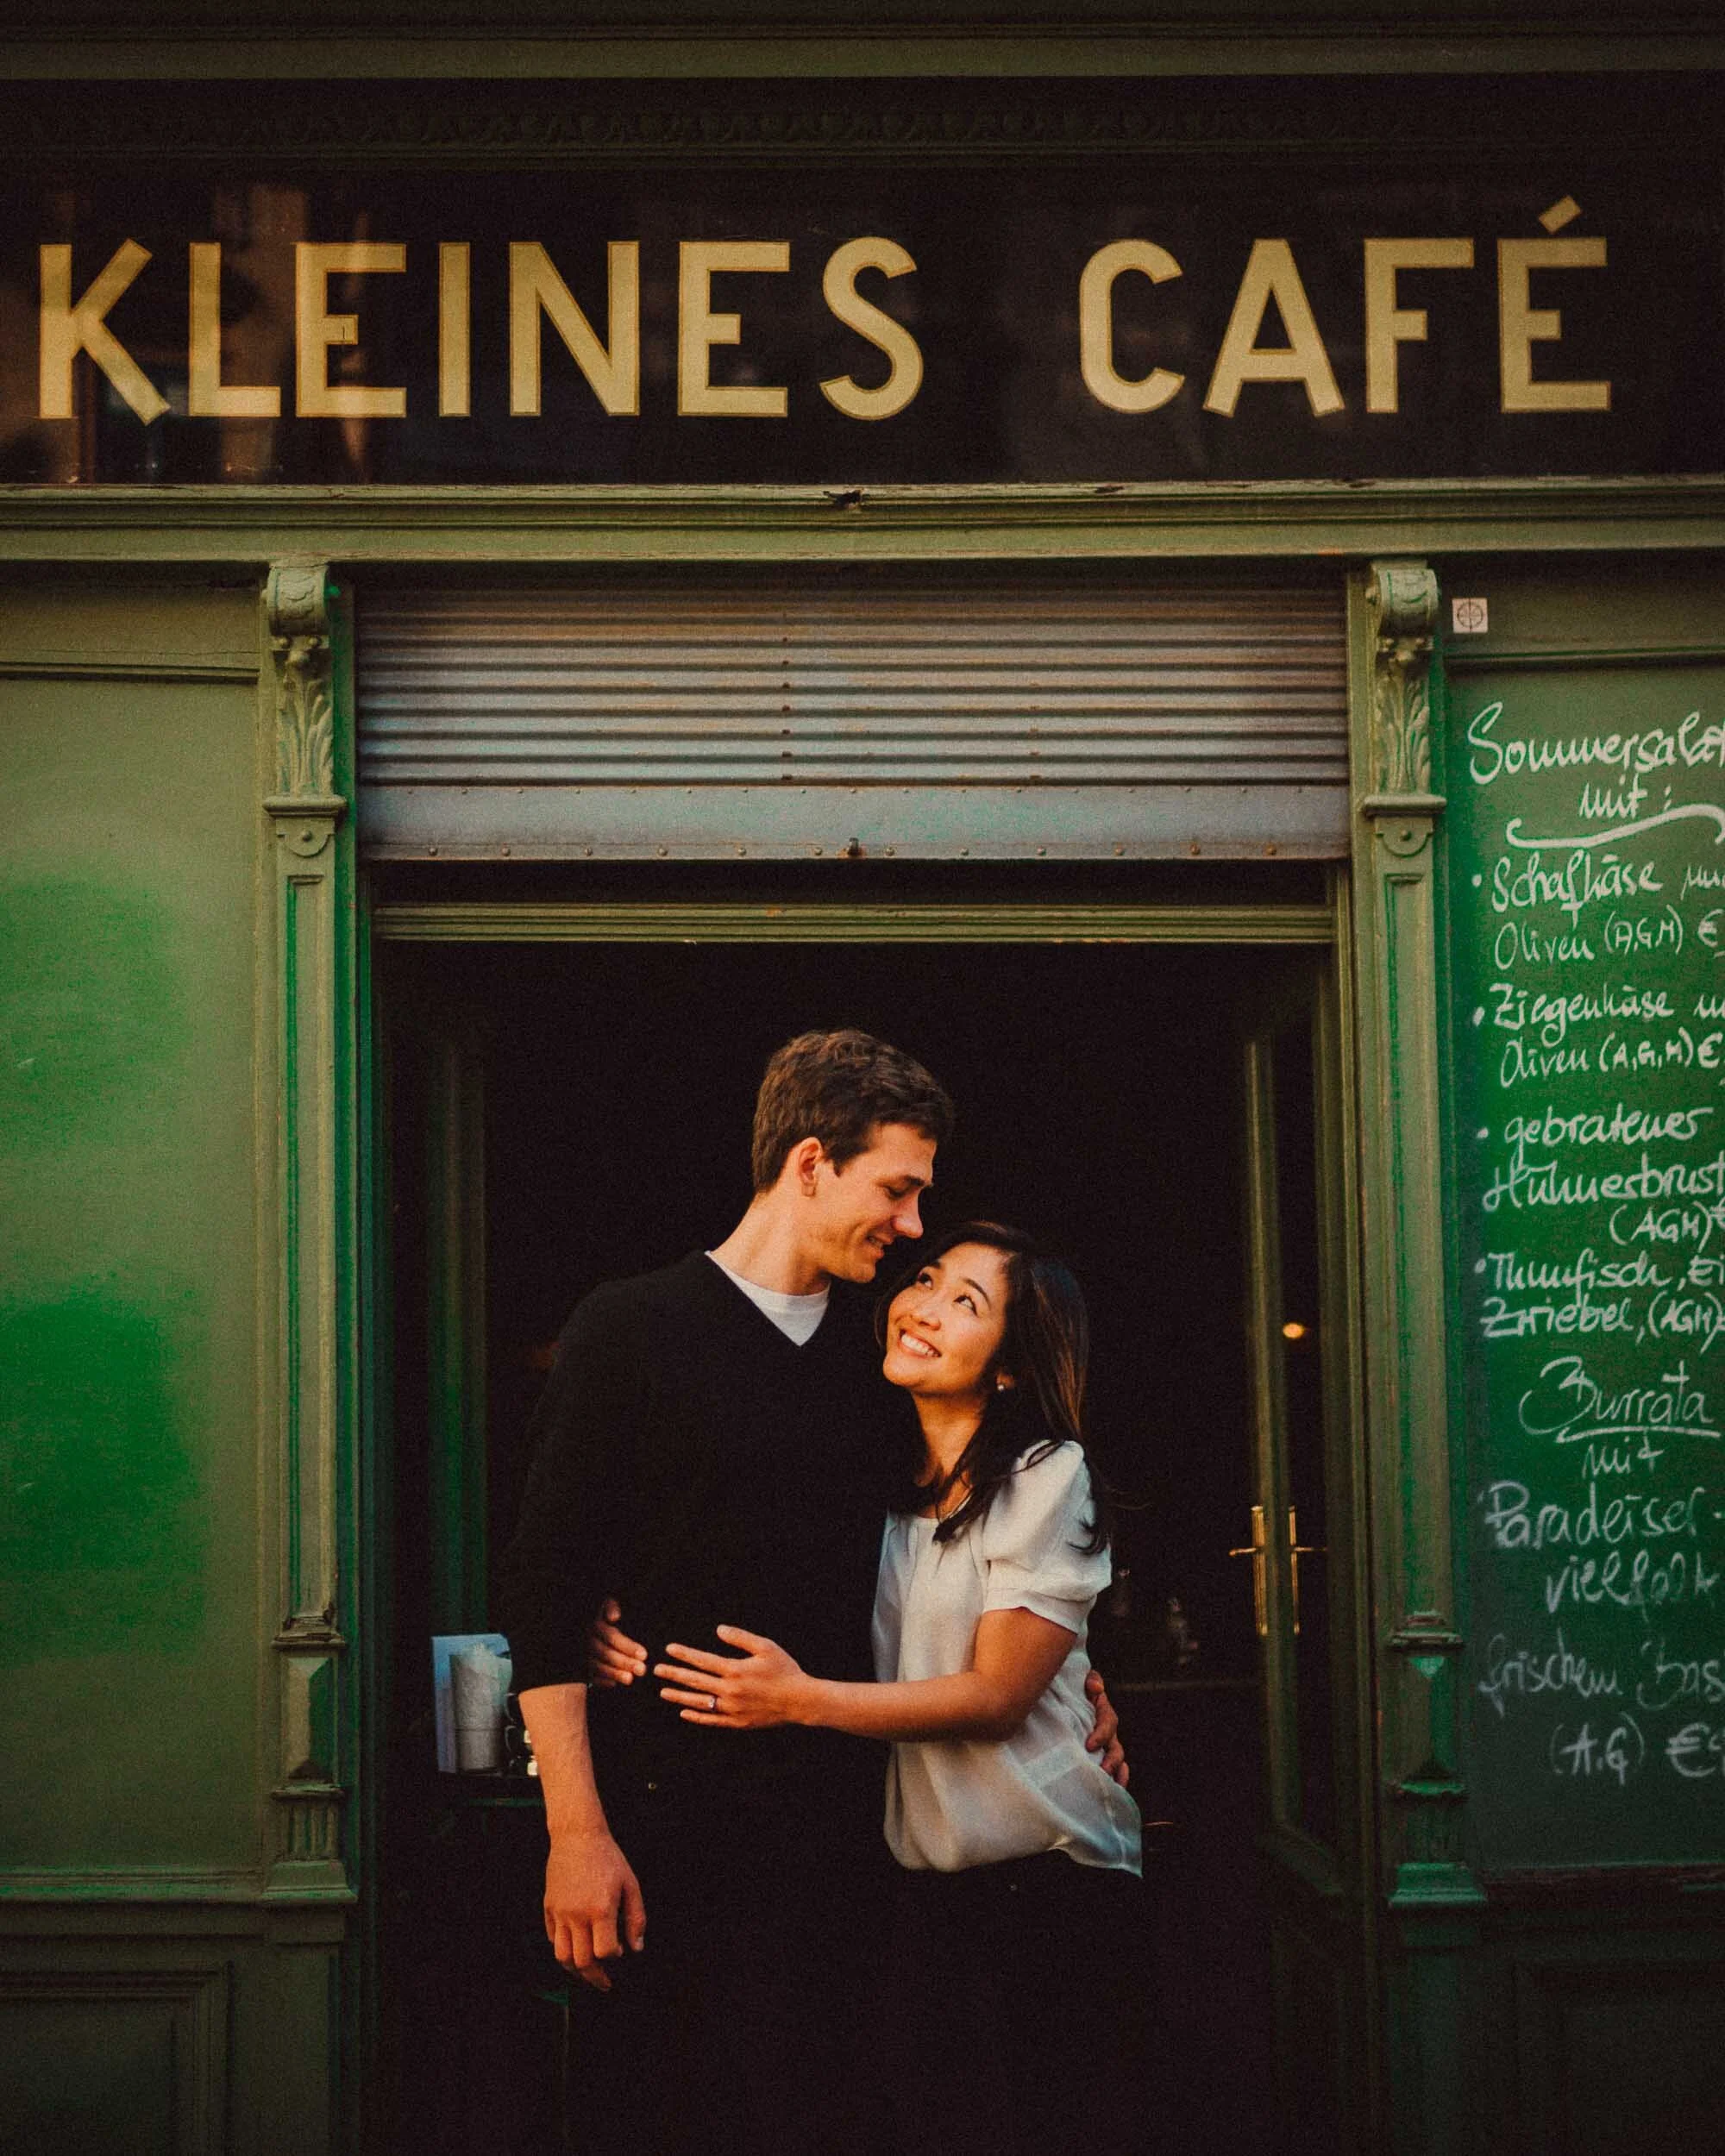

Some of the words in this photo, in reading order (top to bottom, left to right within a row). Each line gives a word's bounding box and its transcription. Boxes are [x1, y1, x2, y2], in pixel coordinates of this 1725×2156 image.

[40, 237, 924, 426] KLEINES
[1079, 196, 1611, 417] CAFÉ
[1495, 917, 1596, 970] Oliven
[1490, 982, 1675, 1047] Ziegenkäse
[1501, 1037, 1590, 1088] Oliven
[1518, 1356, 1715, 1435] Burrata
[1582, 1431, 1665, 1479] mit
